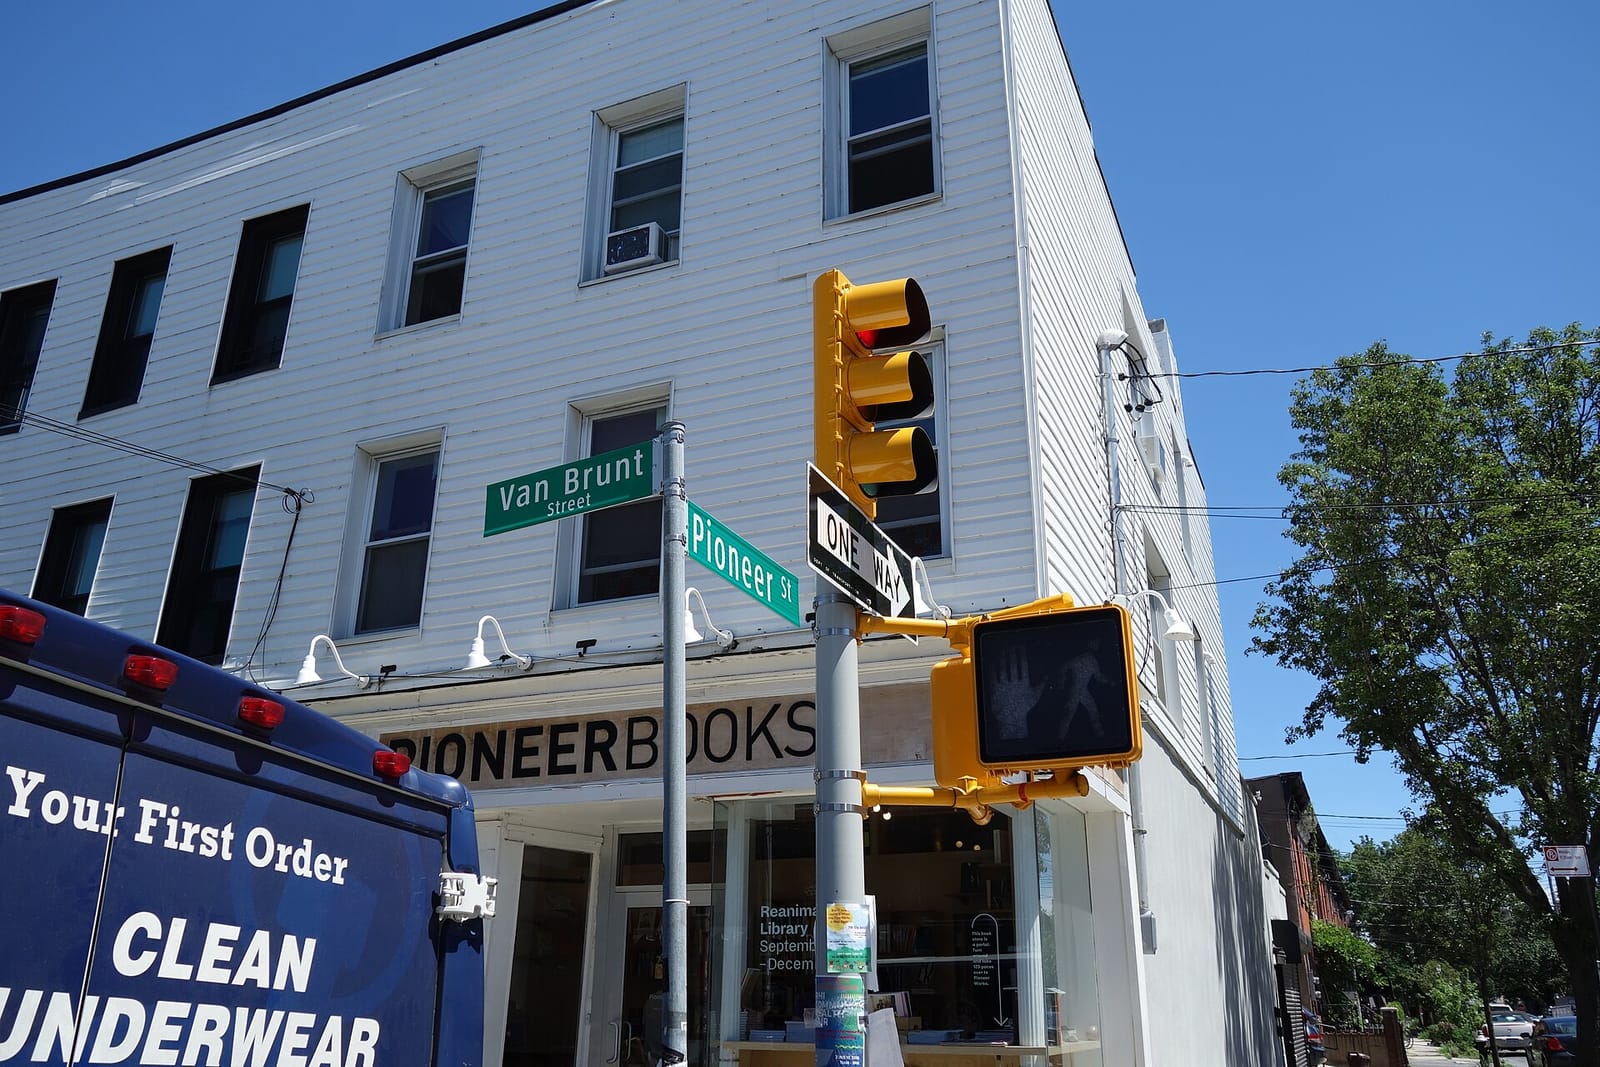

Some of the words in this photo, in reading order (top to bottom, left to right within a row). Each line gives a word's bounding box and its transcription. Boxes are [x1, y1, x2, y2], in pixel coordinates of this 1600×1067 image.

[500, 474, 550, 511] Van
[564, 448, 644, 495] Brunt
[547, 492, 591, 518] Street
[693, 512, 774, 603] Pioneer
[781, 572, 793, 603] St
[827, 513, 859, 570] ONE
[873, 554, 901, 603] WAY
[6, 765, 125, 838] Your
[134, 799, 235, 862] First
[245, 826, 349, 885] Order
[112, 911, 317, 993] CLEAN
[760, 921, 808, 937] Library
[0, 987, 380, 1067] UNDERWEAR
